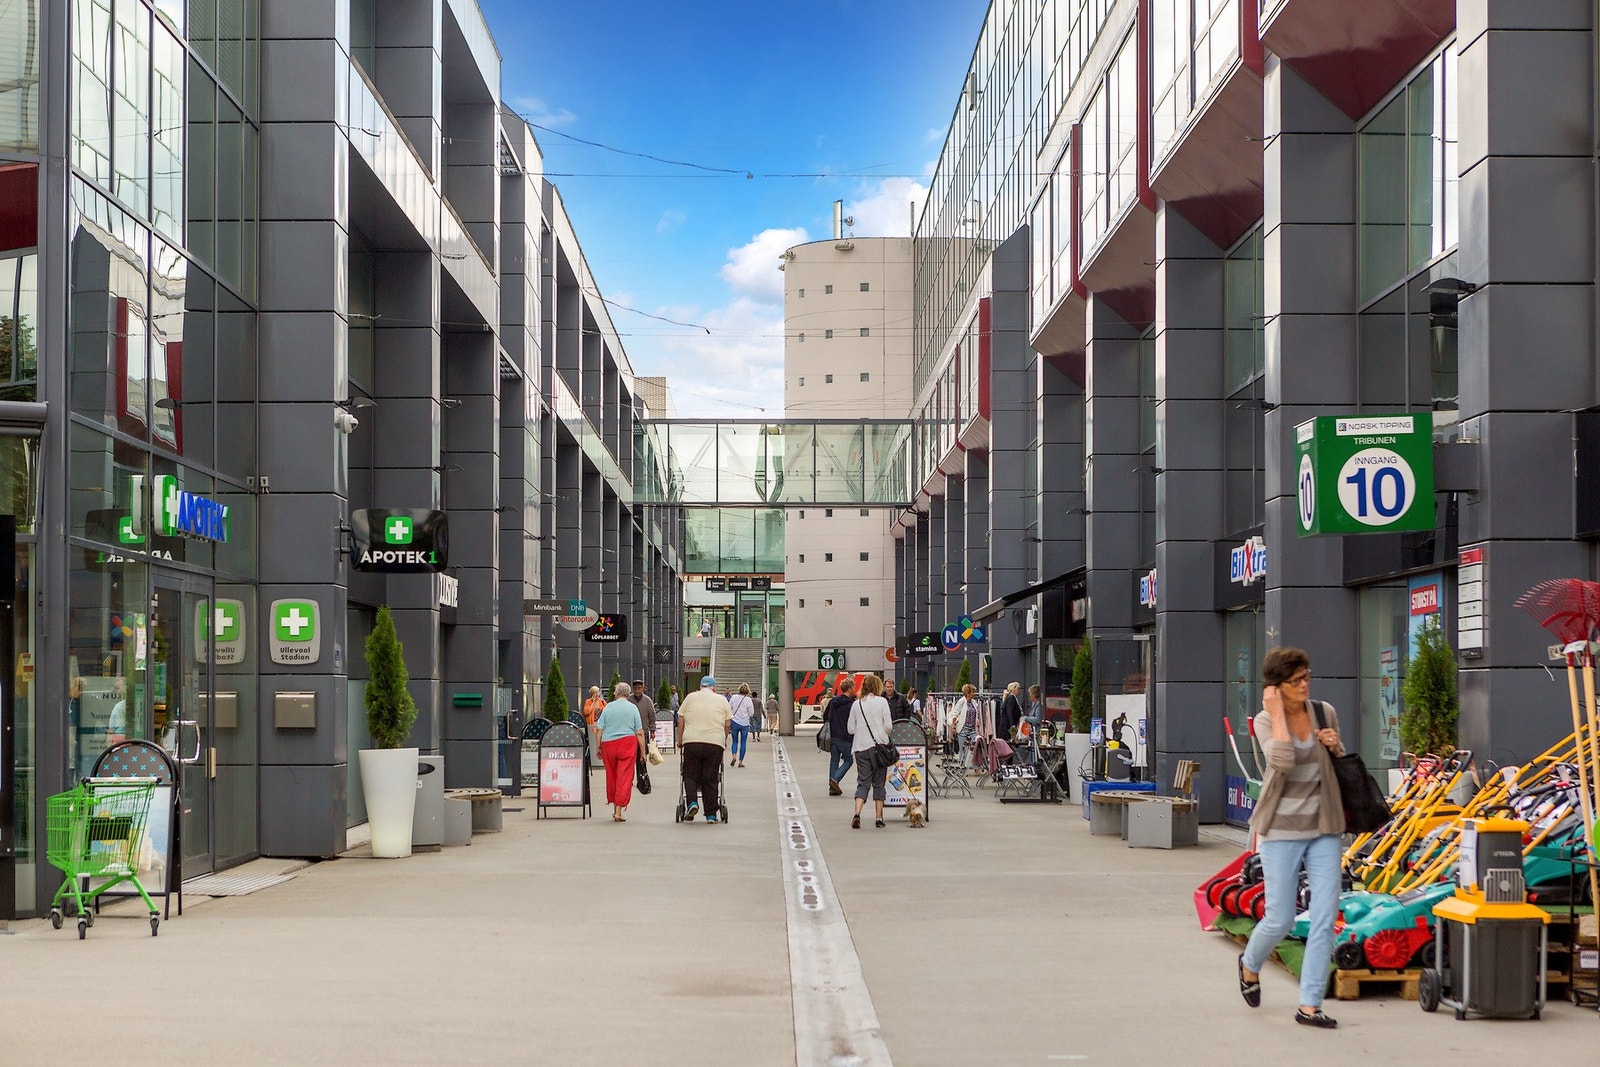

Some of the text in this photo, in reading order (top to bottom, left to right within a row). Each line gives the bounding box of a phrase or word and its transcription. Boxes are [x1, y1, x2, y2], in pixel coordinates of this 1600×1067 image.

[1348, 420, 1411, 430] NORSK TIPPING
[1353, 436, 1396, 445] TRIBUNEN
[1354, 455, 1397, 465] INNGANG
[1300, 471, 1313, 522] 10
[1345, 466, 1406, 518] 10
[945, 630, 958, 643] N
[823, 658, 832, 667] 11
[548, 751, 575, 759] DEALS
